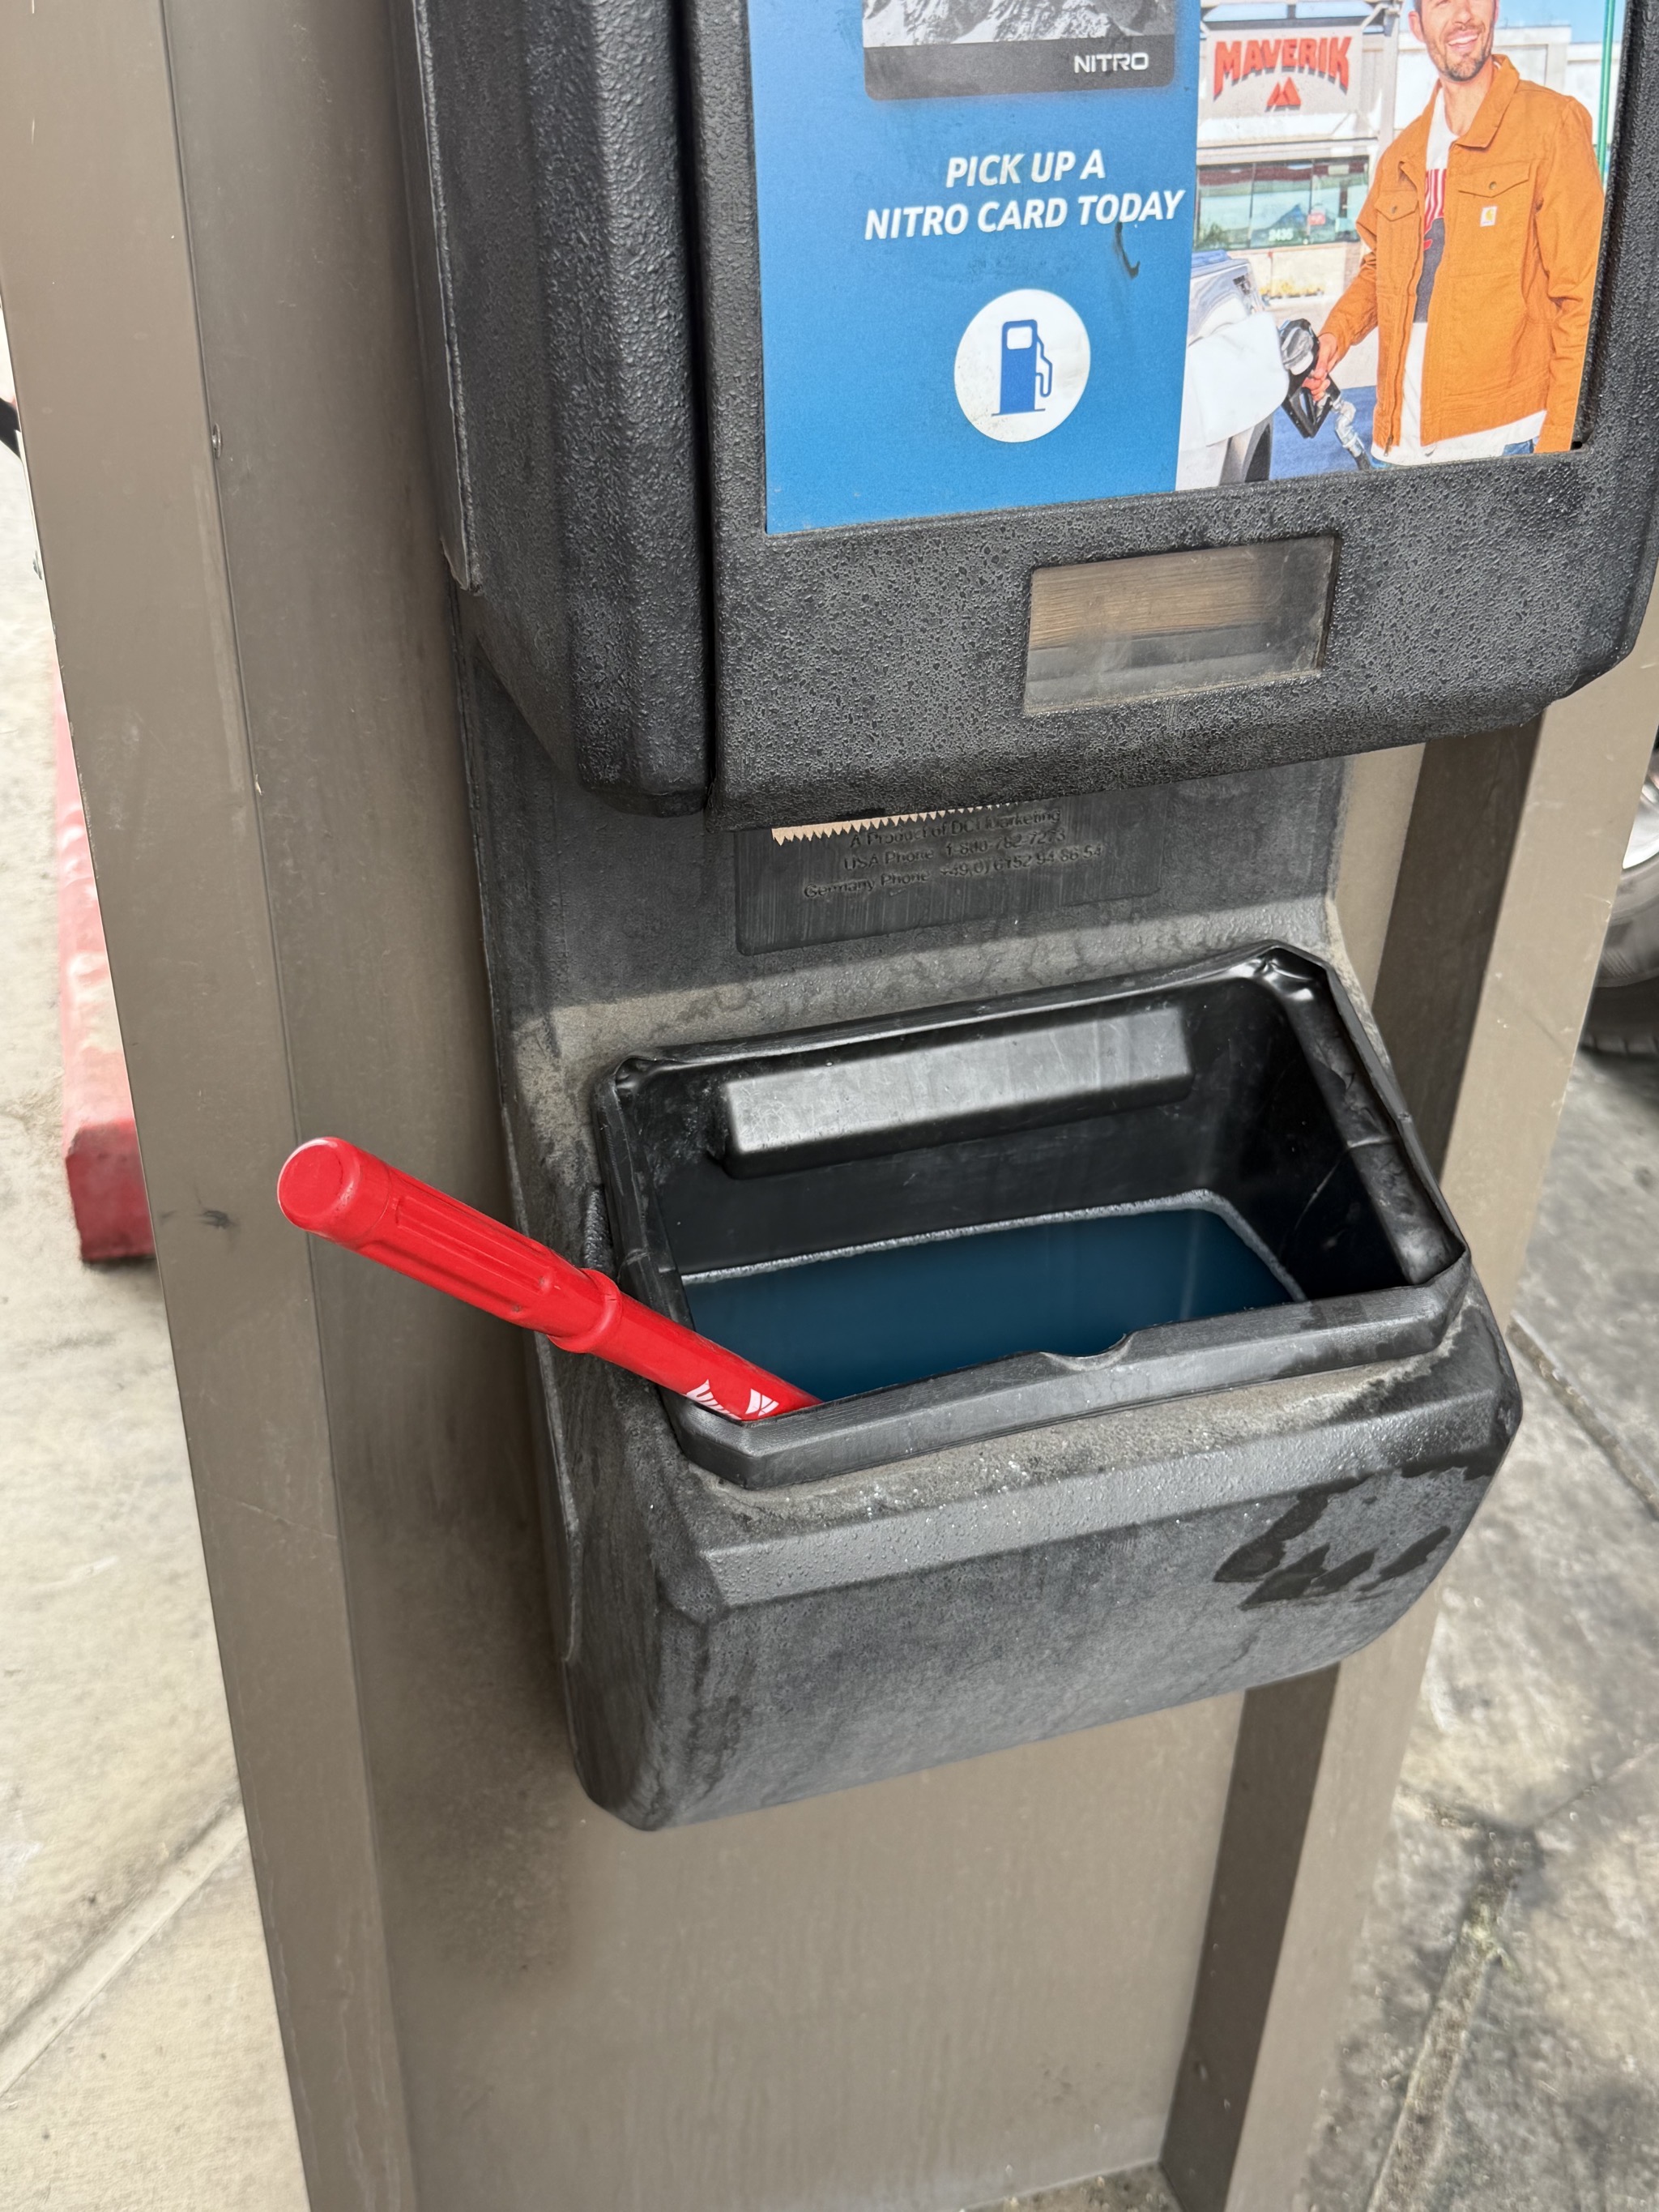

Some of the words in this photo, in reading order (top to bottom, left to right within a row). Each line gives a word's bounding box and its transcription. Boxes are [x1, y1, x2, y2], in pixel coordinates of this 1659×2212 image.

[1074, 52, 1149, 74] NITRO
[1213, 36, 1352, 99] MAVERIK
[945, 152, 1026, 188] PICK
[1030, 150, 1076, 182] UP
[1079, 148, 1105, 180] A
[864, 203, 969, 241] NITRO
[977, 197, 1068, 233] CARD
[1077, 190, 1186, 226] TODAY
[851, 834, 861, 848] A
[867, 825, 927, 845] Product
[932, 822, 946, 836] of
[985, 810, 1061, 829] Marketing
[844, 853, 878, 870] USA
[885, 850, 934, 865] Phone
[804, 878, 875, 898] Germany
[881, 870, 932, 886] Phone
